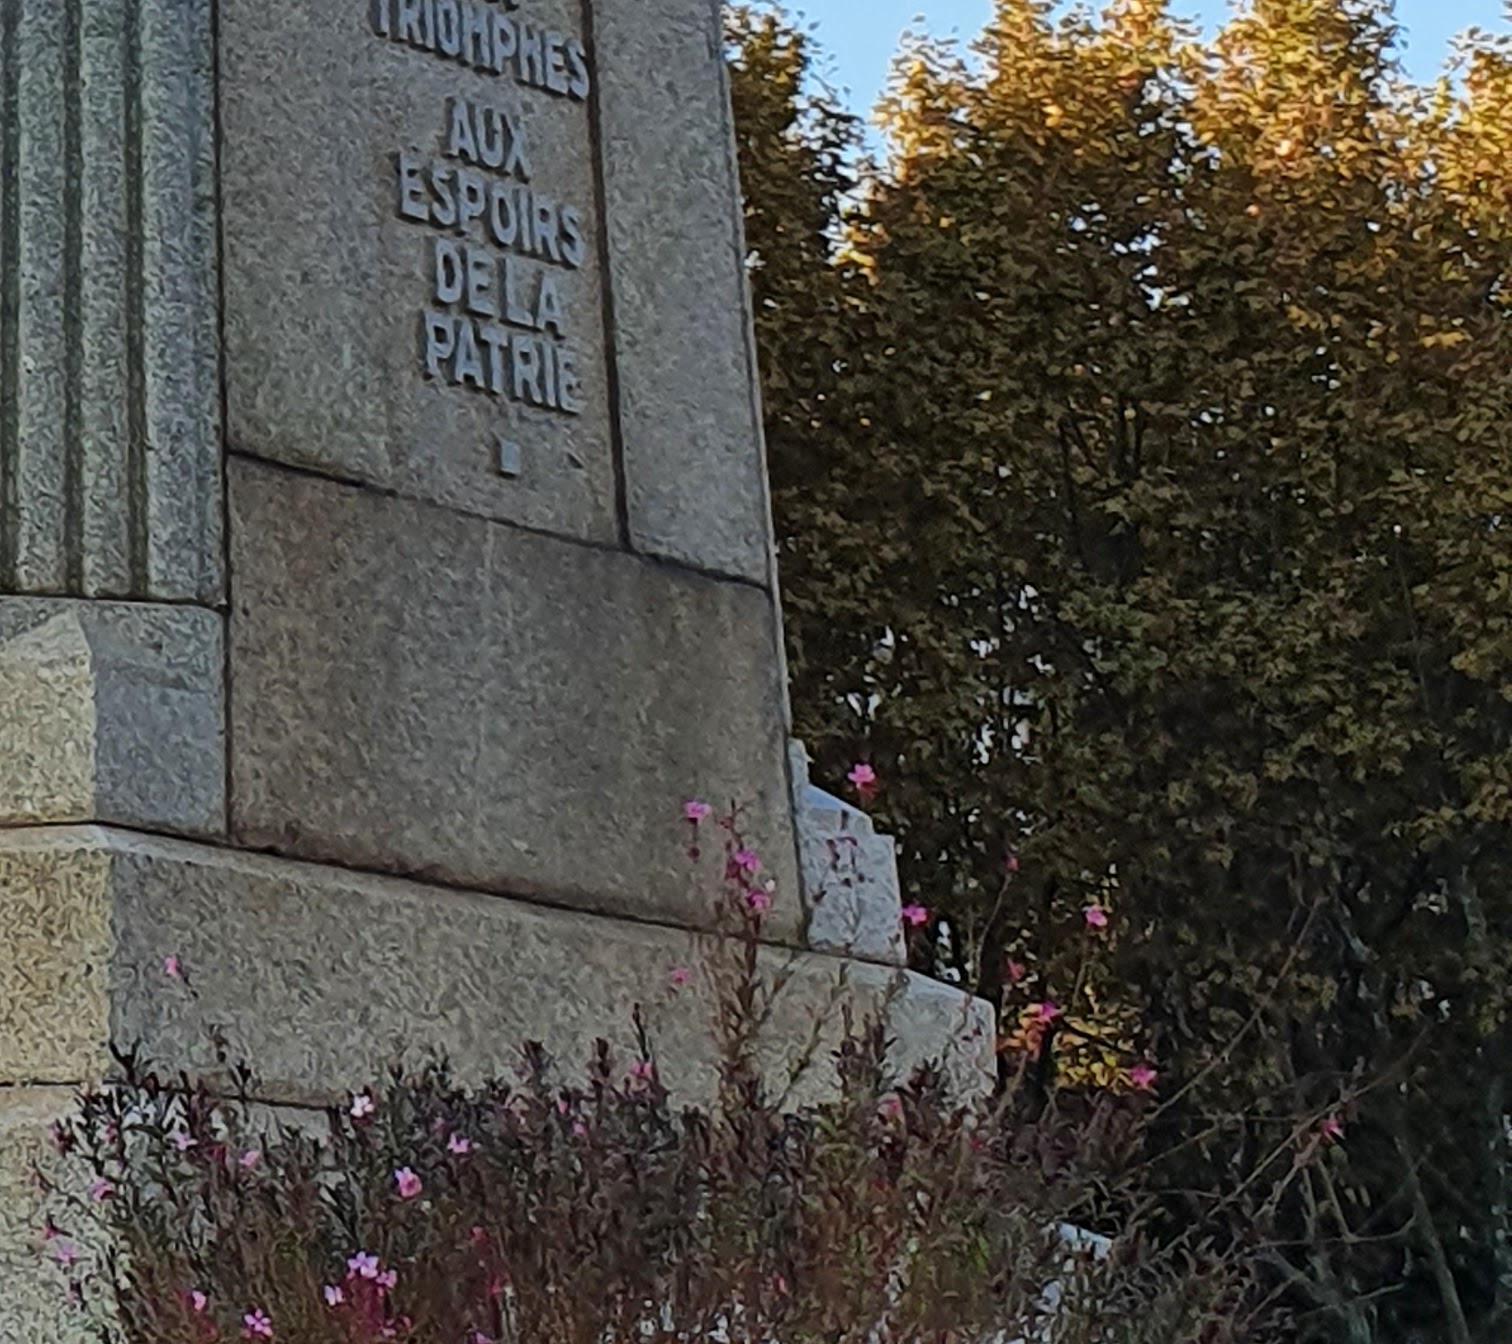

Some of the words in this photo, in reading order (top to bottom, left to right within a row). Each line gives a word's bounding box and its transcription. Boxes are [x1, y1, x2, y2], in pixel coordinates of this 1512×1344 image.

[446, 98, 531, 183] AUX
[396, 150, 584, 268] ESPOIRS
[434, 237, 493, 317] DE
[502, 254, 565, 339] LA
[423, 309, 584, 413] PATRIE
